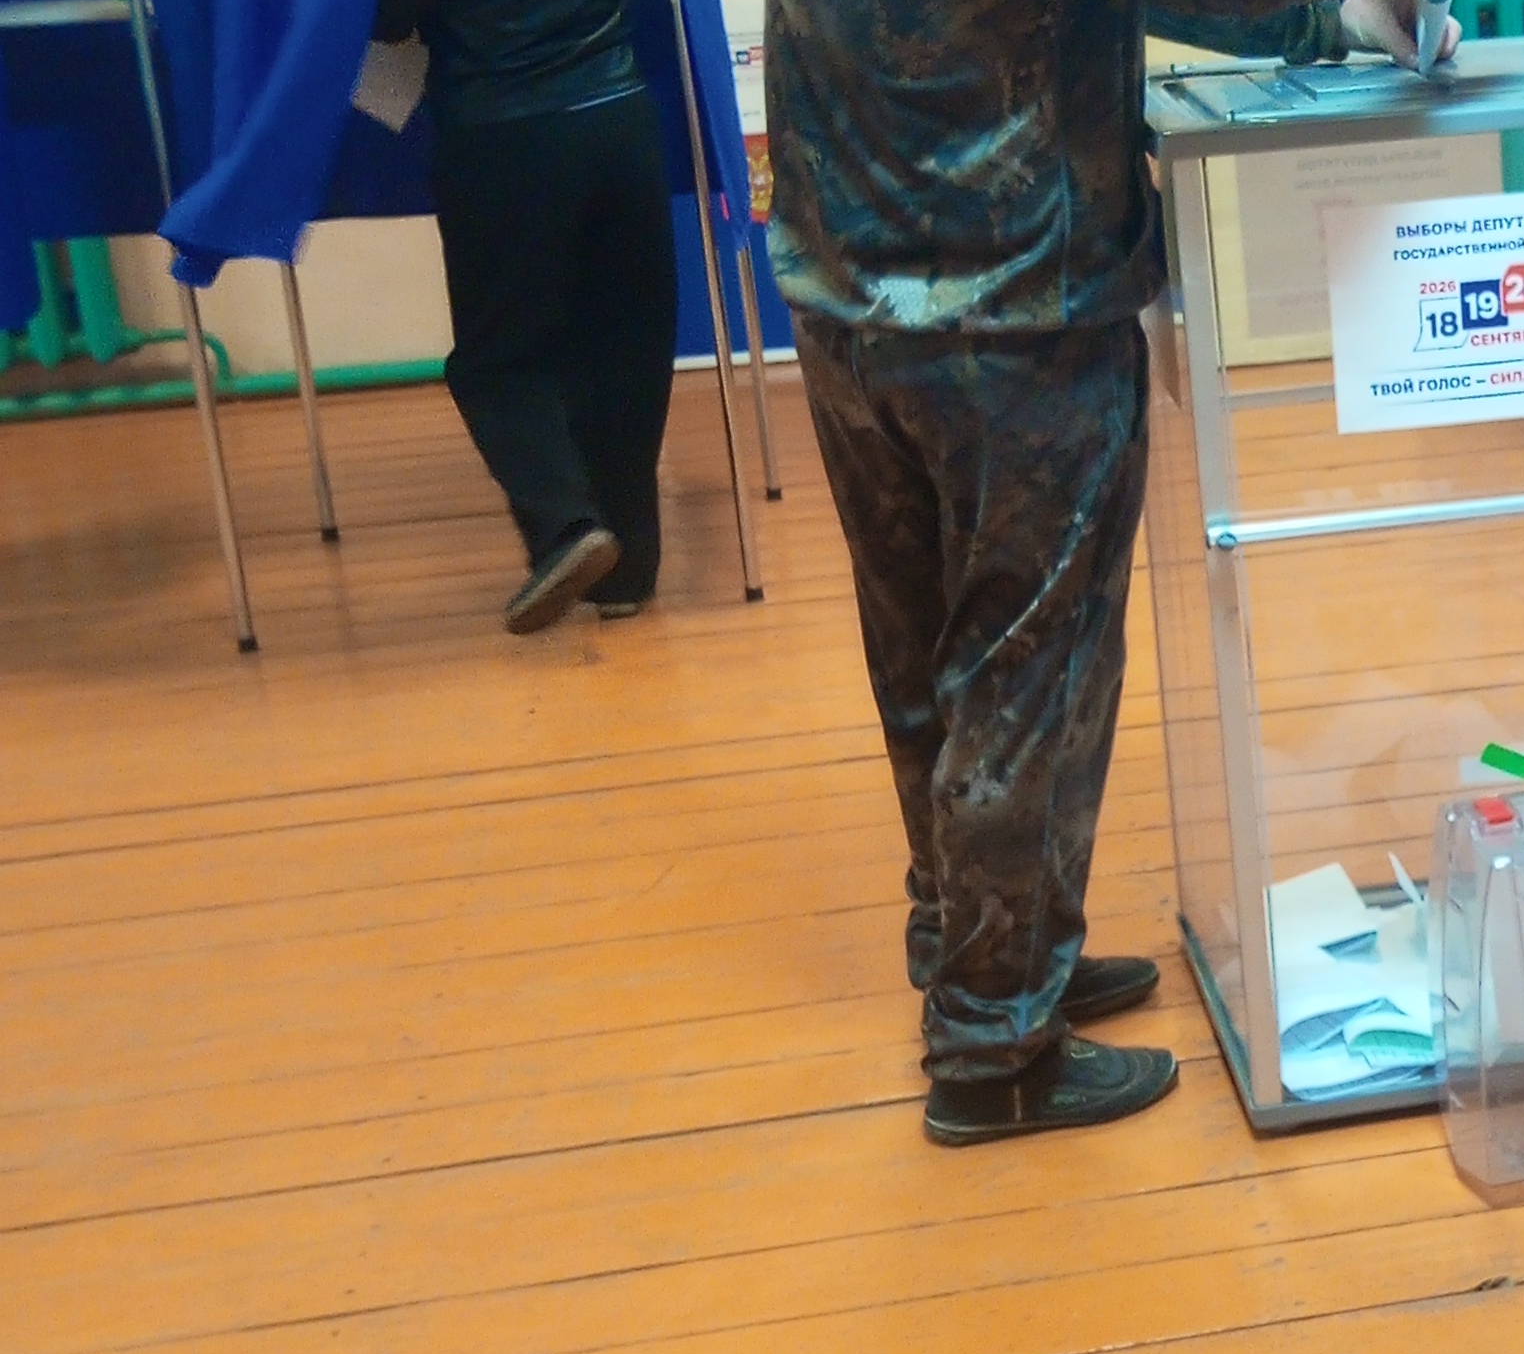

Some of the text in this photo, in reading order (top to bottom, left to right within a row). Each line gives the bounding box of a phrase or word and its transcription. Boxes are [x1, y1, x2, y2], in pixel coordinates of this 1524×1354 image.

[1396, 220, 1467, 238] ВЫБОРЫ
[1419, 280, 1456, 294] 2026
[1425, 311, 1459, 338] 18
[1464, 290, 1499, 321] 19
[1370, 378, 1414, 396] ТВОЙ
[1418, 376, 1471, 392] ГОЛОС
